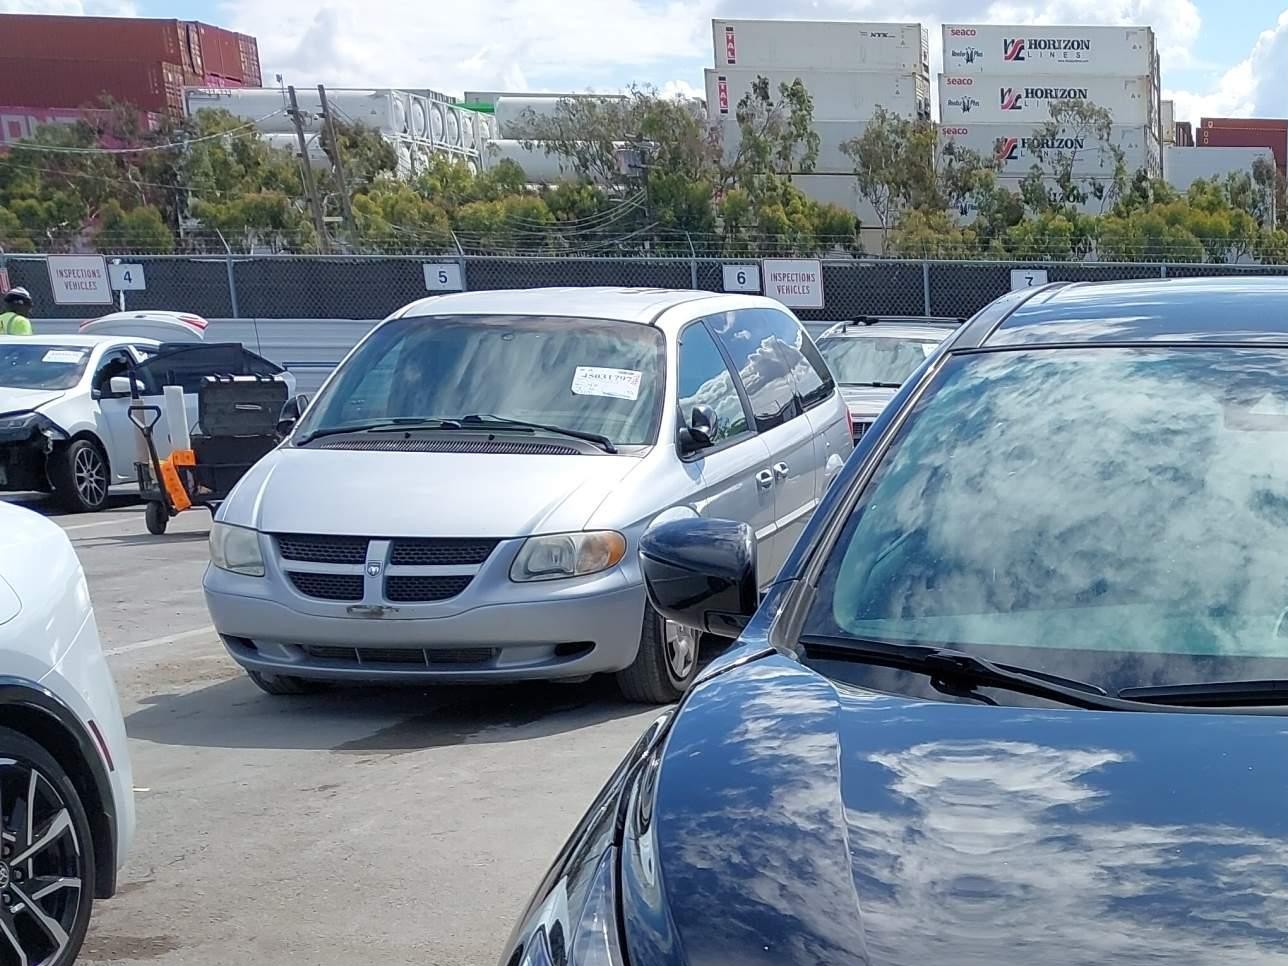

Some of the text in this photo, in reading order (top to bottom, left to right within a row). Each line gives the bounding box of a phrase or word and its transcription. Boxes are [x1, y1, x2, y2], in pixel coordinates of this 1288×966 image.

[951, 28, 976, 36] seaco
[727, 32, 736, 58] TAL
[1027, 39, 1090, 50] HORIZON
[1027, 51, 1081, 59] LINES
[946, 77, 973, 85] seaco
[719, 83, 728, 108] TAL
[1024, 88, 1088, 99] HORIZON
[942, 127, 968, 135] seaco
[56, 269, 101, 278] INSPECTIONS
[123, 270, 132, 284] 4
[438, 270, 448, 284] 5
[737, 271, 746, 285] 6
[770, 271, 816, 282] INSPECTIONS
[64, 281, 98, 290] VEHICLES
[1025, 276, 1034, 287] 7
[776, 285, 810, 295] VEHICLES
